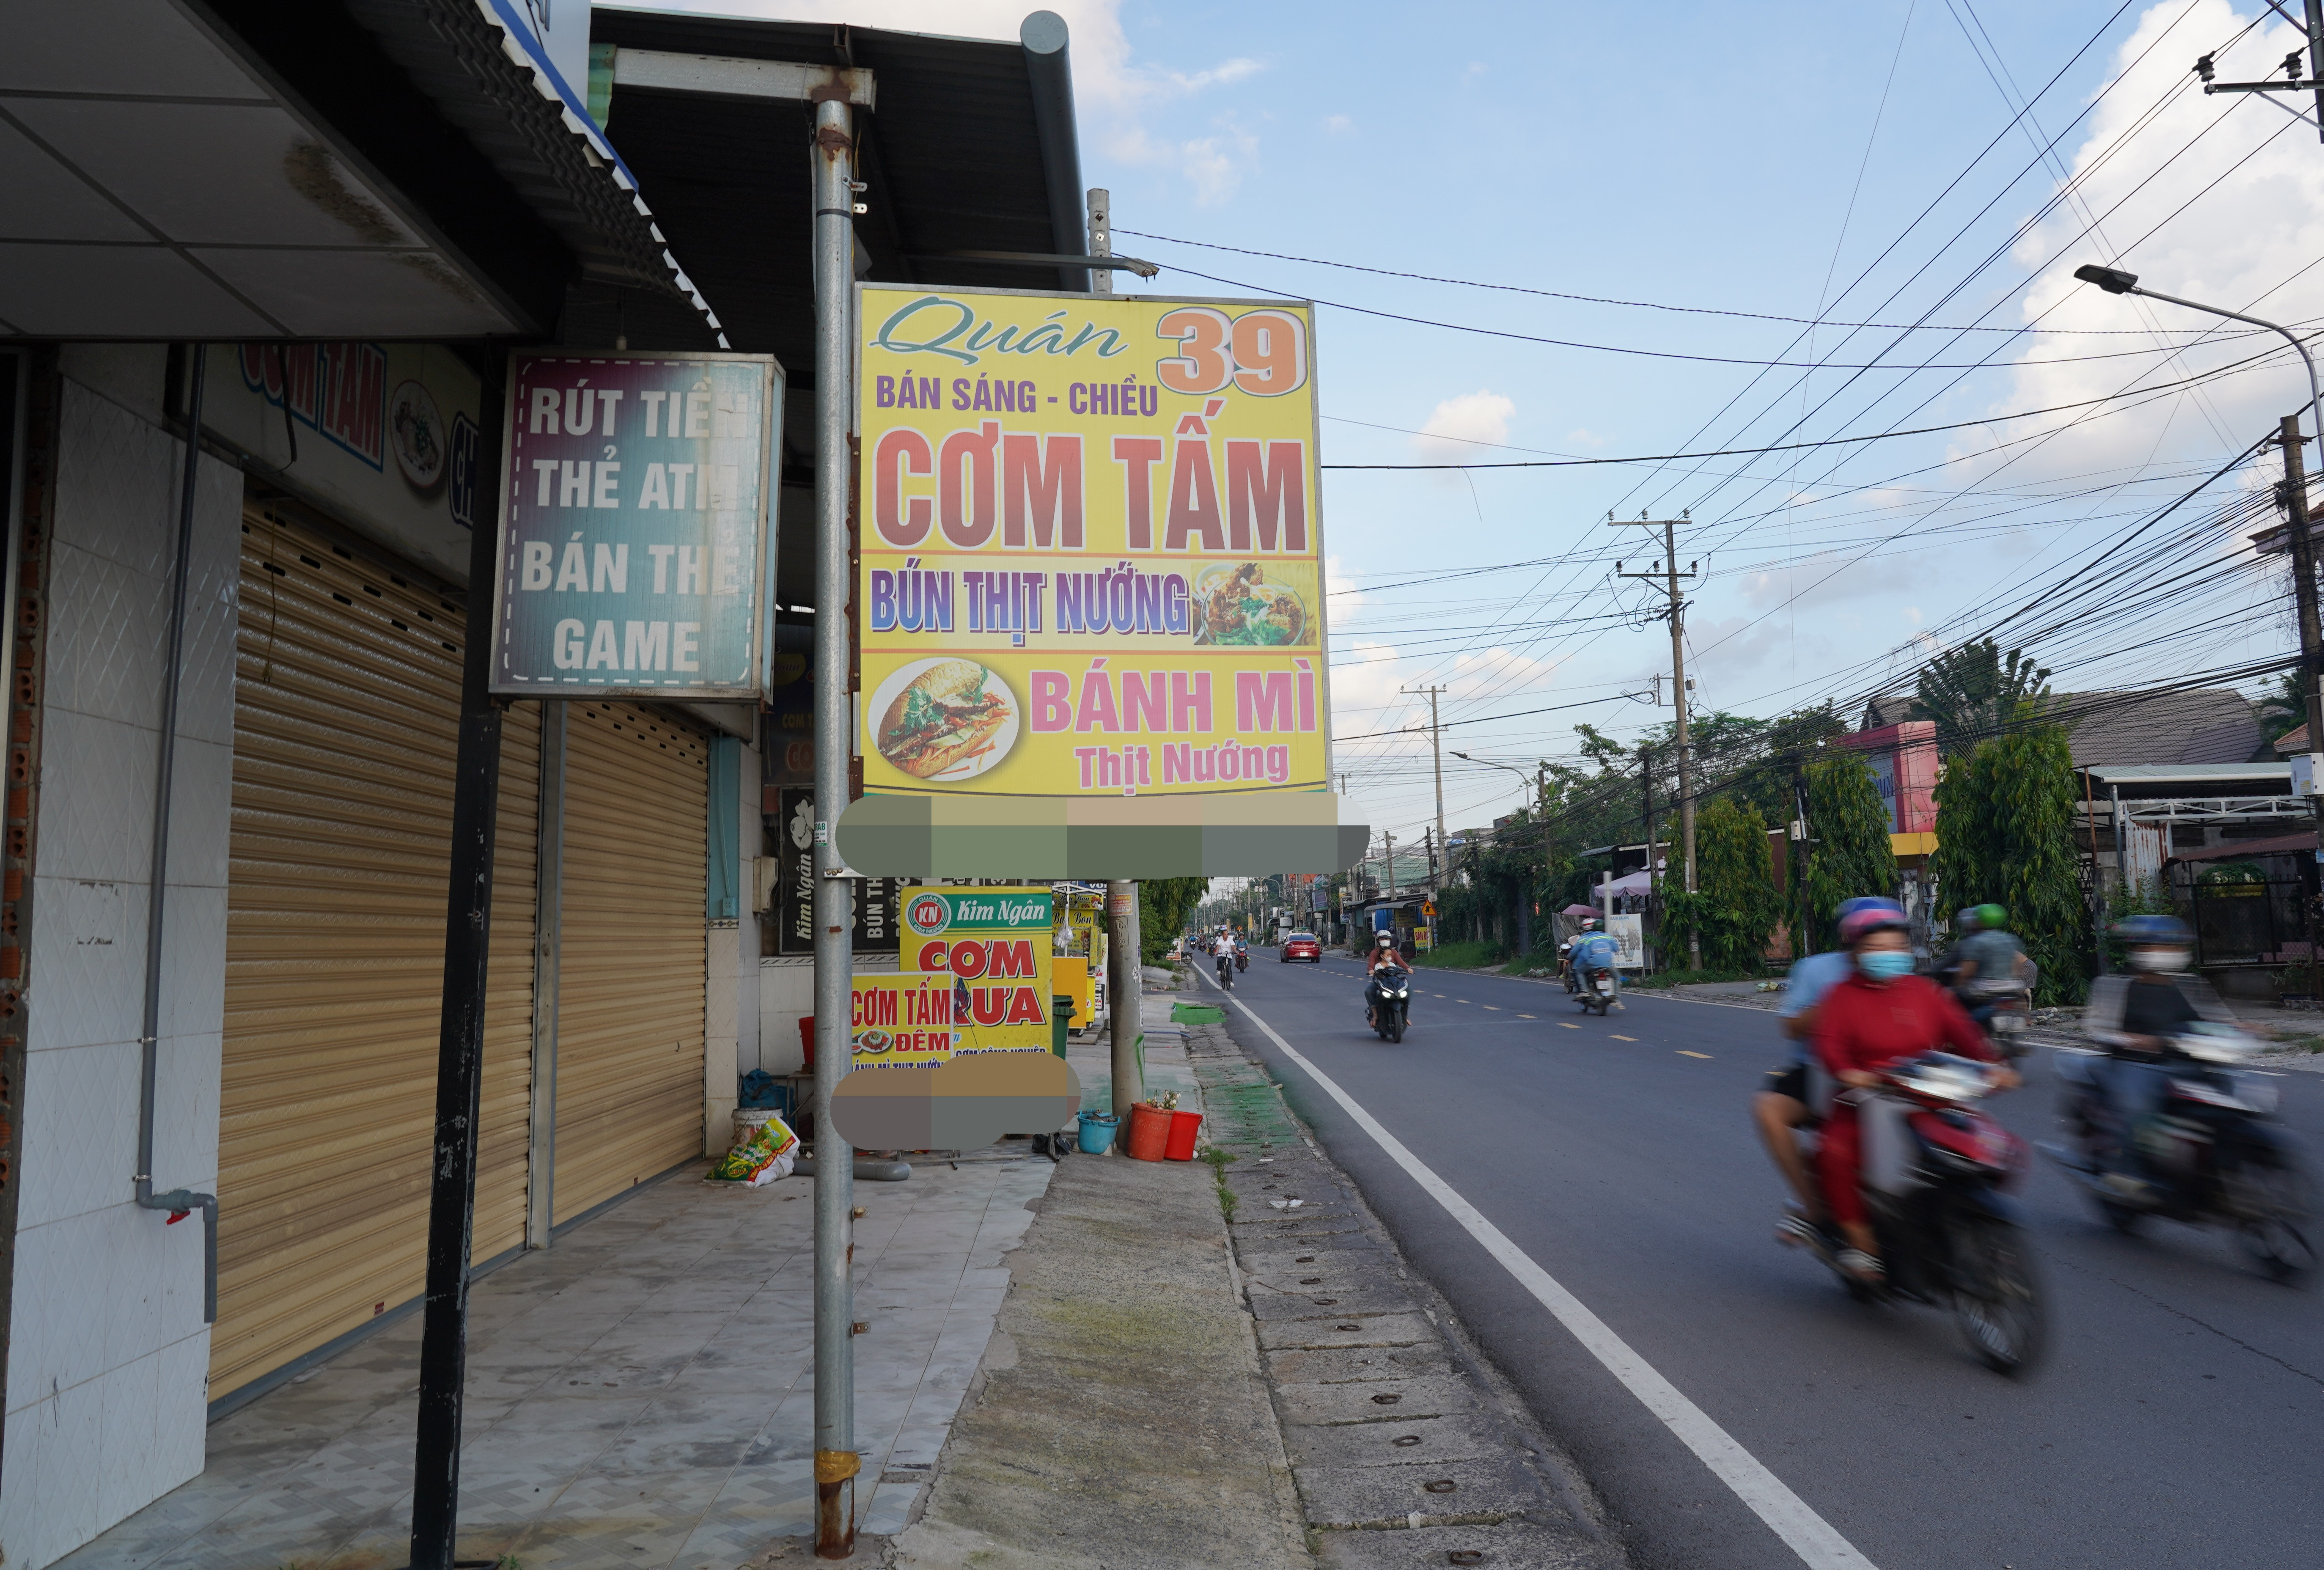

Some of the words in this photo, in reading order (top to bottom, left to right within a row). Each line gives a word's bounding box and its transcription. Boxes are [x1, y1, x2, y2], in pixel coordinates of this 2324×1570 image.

[868, 296, 1129, 366] Quán
[1156, 307, 1308, 397] 39
[530, 378, 623, 437] RÚT
[641, 377, 747, 438] TIỀN
[876, 370, 940, 410] BÁN
[952, 372, 1036, 413] SÁNG
[1069, 374, 1158, 417] CHIỀU
[533, 445, 621, 508] THẺ
[639, 463, 738, 510] ATM
[875, 421, 1084, 549] CƠM
[1112, 399, 1307, 552] TẤM
[521, 532, 628, 593] BÁN
[649, 530, 739, 596] THẺ
[869, 557, 954, 633] BÚN
[963, 571, 1047, 647] THỊT
[1056, 561, 1191, 637] NƯỚNG
[554, 618, 699, 671] GAME
[1029, 657, 1213, 735] BÁNH
[1236, 658, 1317, 733] MÌ
[1075, 745, 1151, 796] Thịt
[1164, 737, 1290, 784] Nướng
[796, 854, 815, 900] Ngân
[867, 878, 883, 898] TH
[796, 904, 812, 940] Kim
[863, 904, 883, 938] BÚN
[913, 924, 925, 933] KIM
[918, 906, 938, 923] KN
[957, 900, 993, 921] Kim
[997, 899, 1044, 925] Ngân
[1074, 912, 1091, 924] Bon
[918, 939, 1036, 979] CƠM
[852, 986, 898, 1027] CƠM
[904, 976, 950, 1026] TẤM
[895, 1029, 950, 1052] ĐÊM
